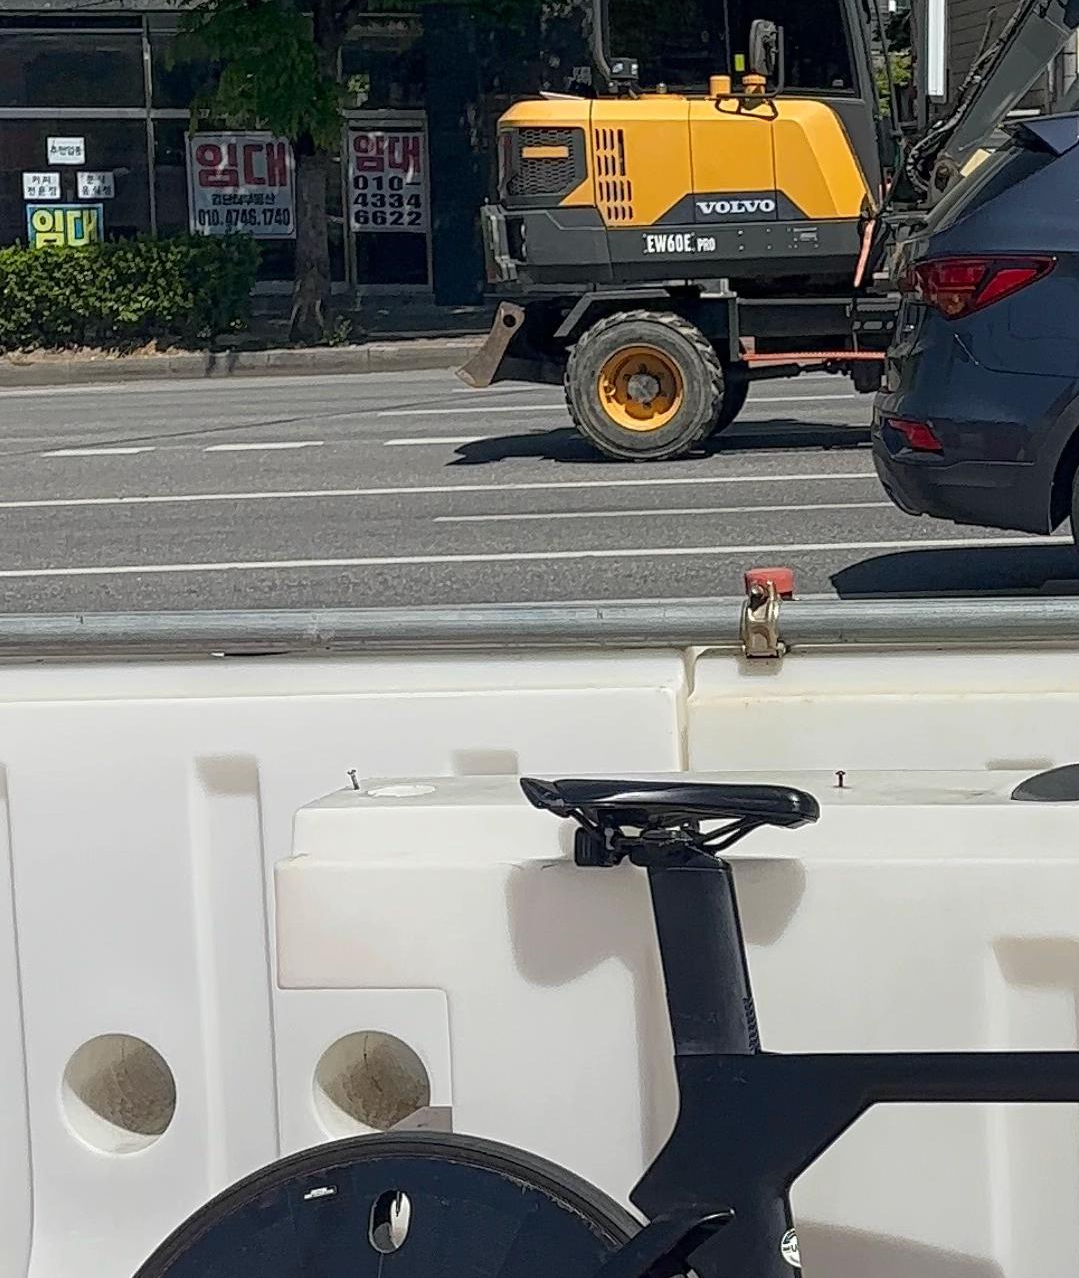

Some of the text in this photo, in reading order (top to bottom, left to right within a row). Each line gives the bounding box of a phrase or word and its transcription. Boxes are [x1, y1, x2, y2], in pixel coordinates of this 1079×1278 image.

[353, 134, 421, 173] 임대
[195, 141, 288, 188] 임대
[353, 175, 422, 191] 010-
[353, 193, 422, 208] 4334
[696, 198, 776, 215] VOLVO
[354, 210, 422, 227] 6622
[31, 208, 98, 250] 임대
[646, 233, 716, 253] EW60E PRO
